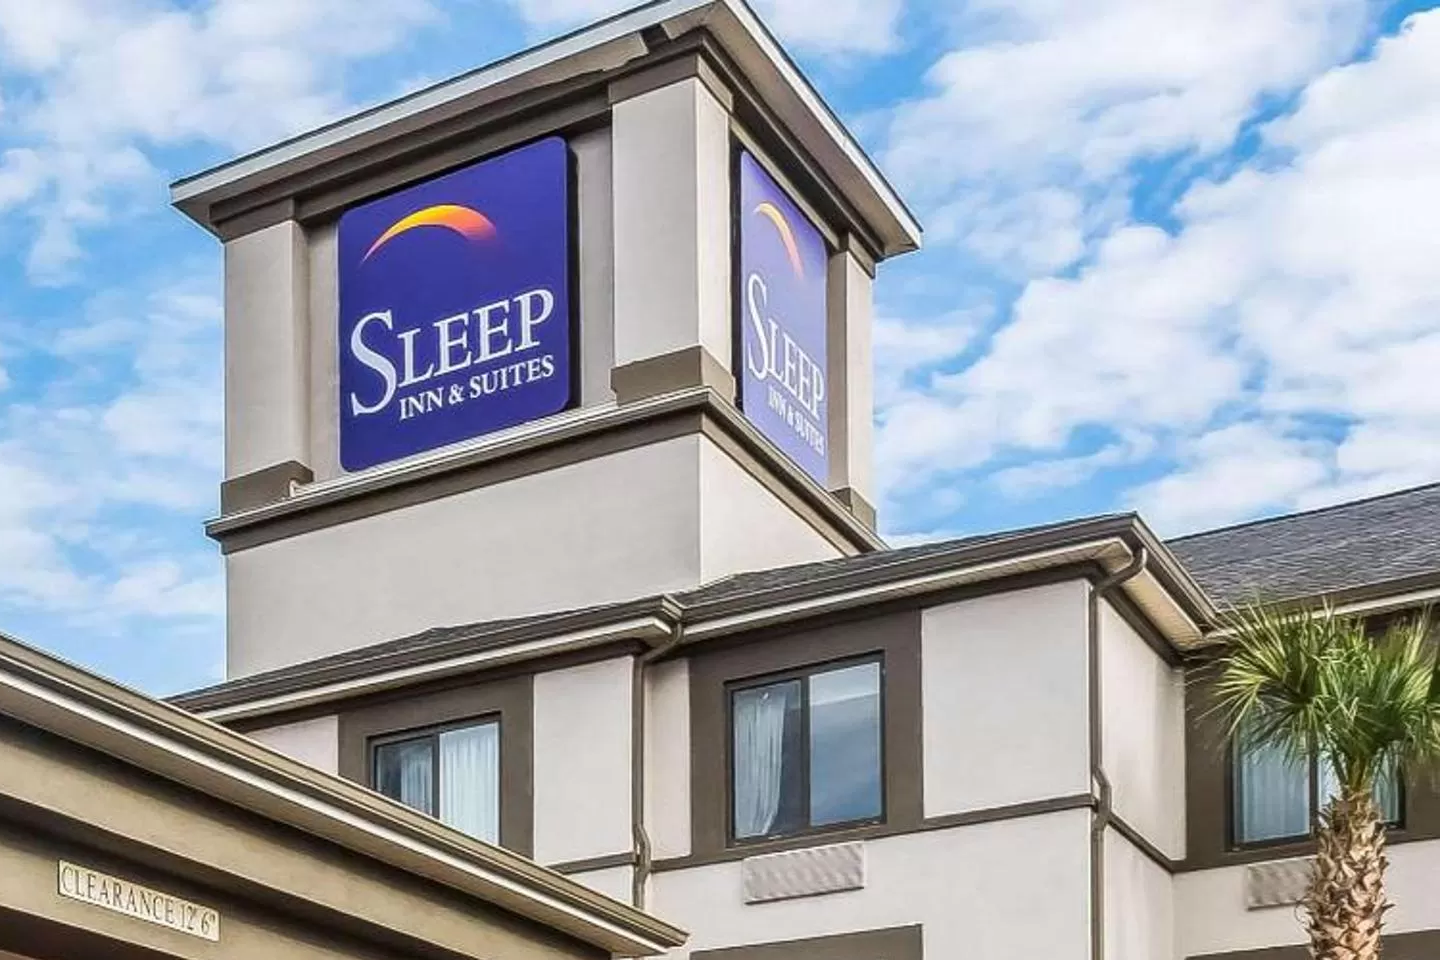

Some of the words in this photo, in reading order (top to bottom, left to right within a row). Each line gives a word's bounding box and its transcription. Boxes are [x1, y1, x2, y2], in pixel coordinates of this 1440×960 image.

[350, 288, 554, 416] SLEEP
[399, 387, 444, 421] INN
[448, 384, 464, 405] &
[469, 354, 555, 399] SUITES
[748, 274, 825, 420] SLEEP
[62, 865, 174, 924] CLEARANCE
